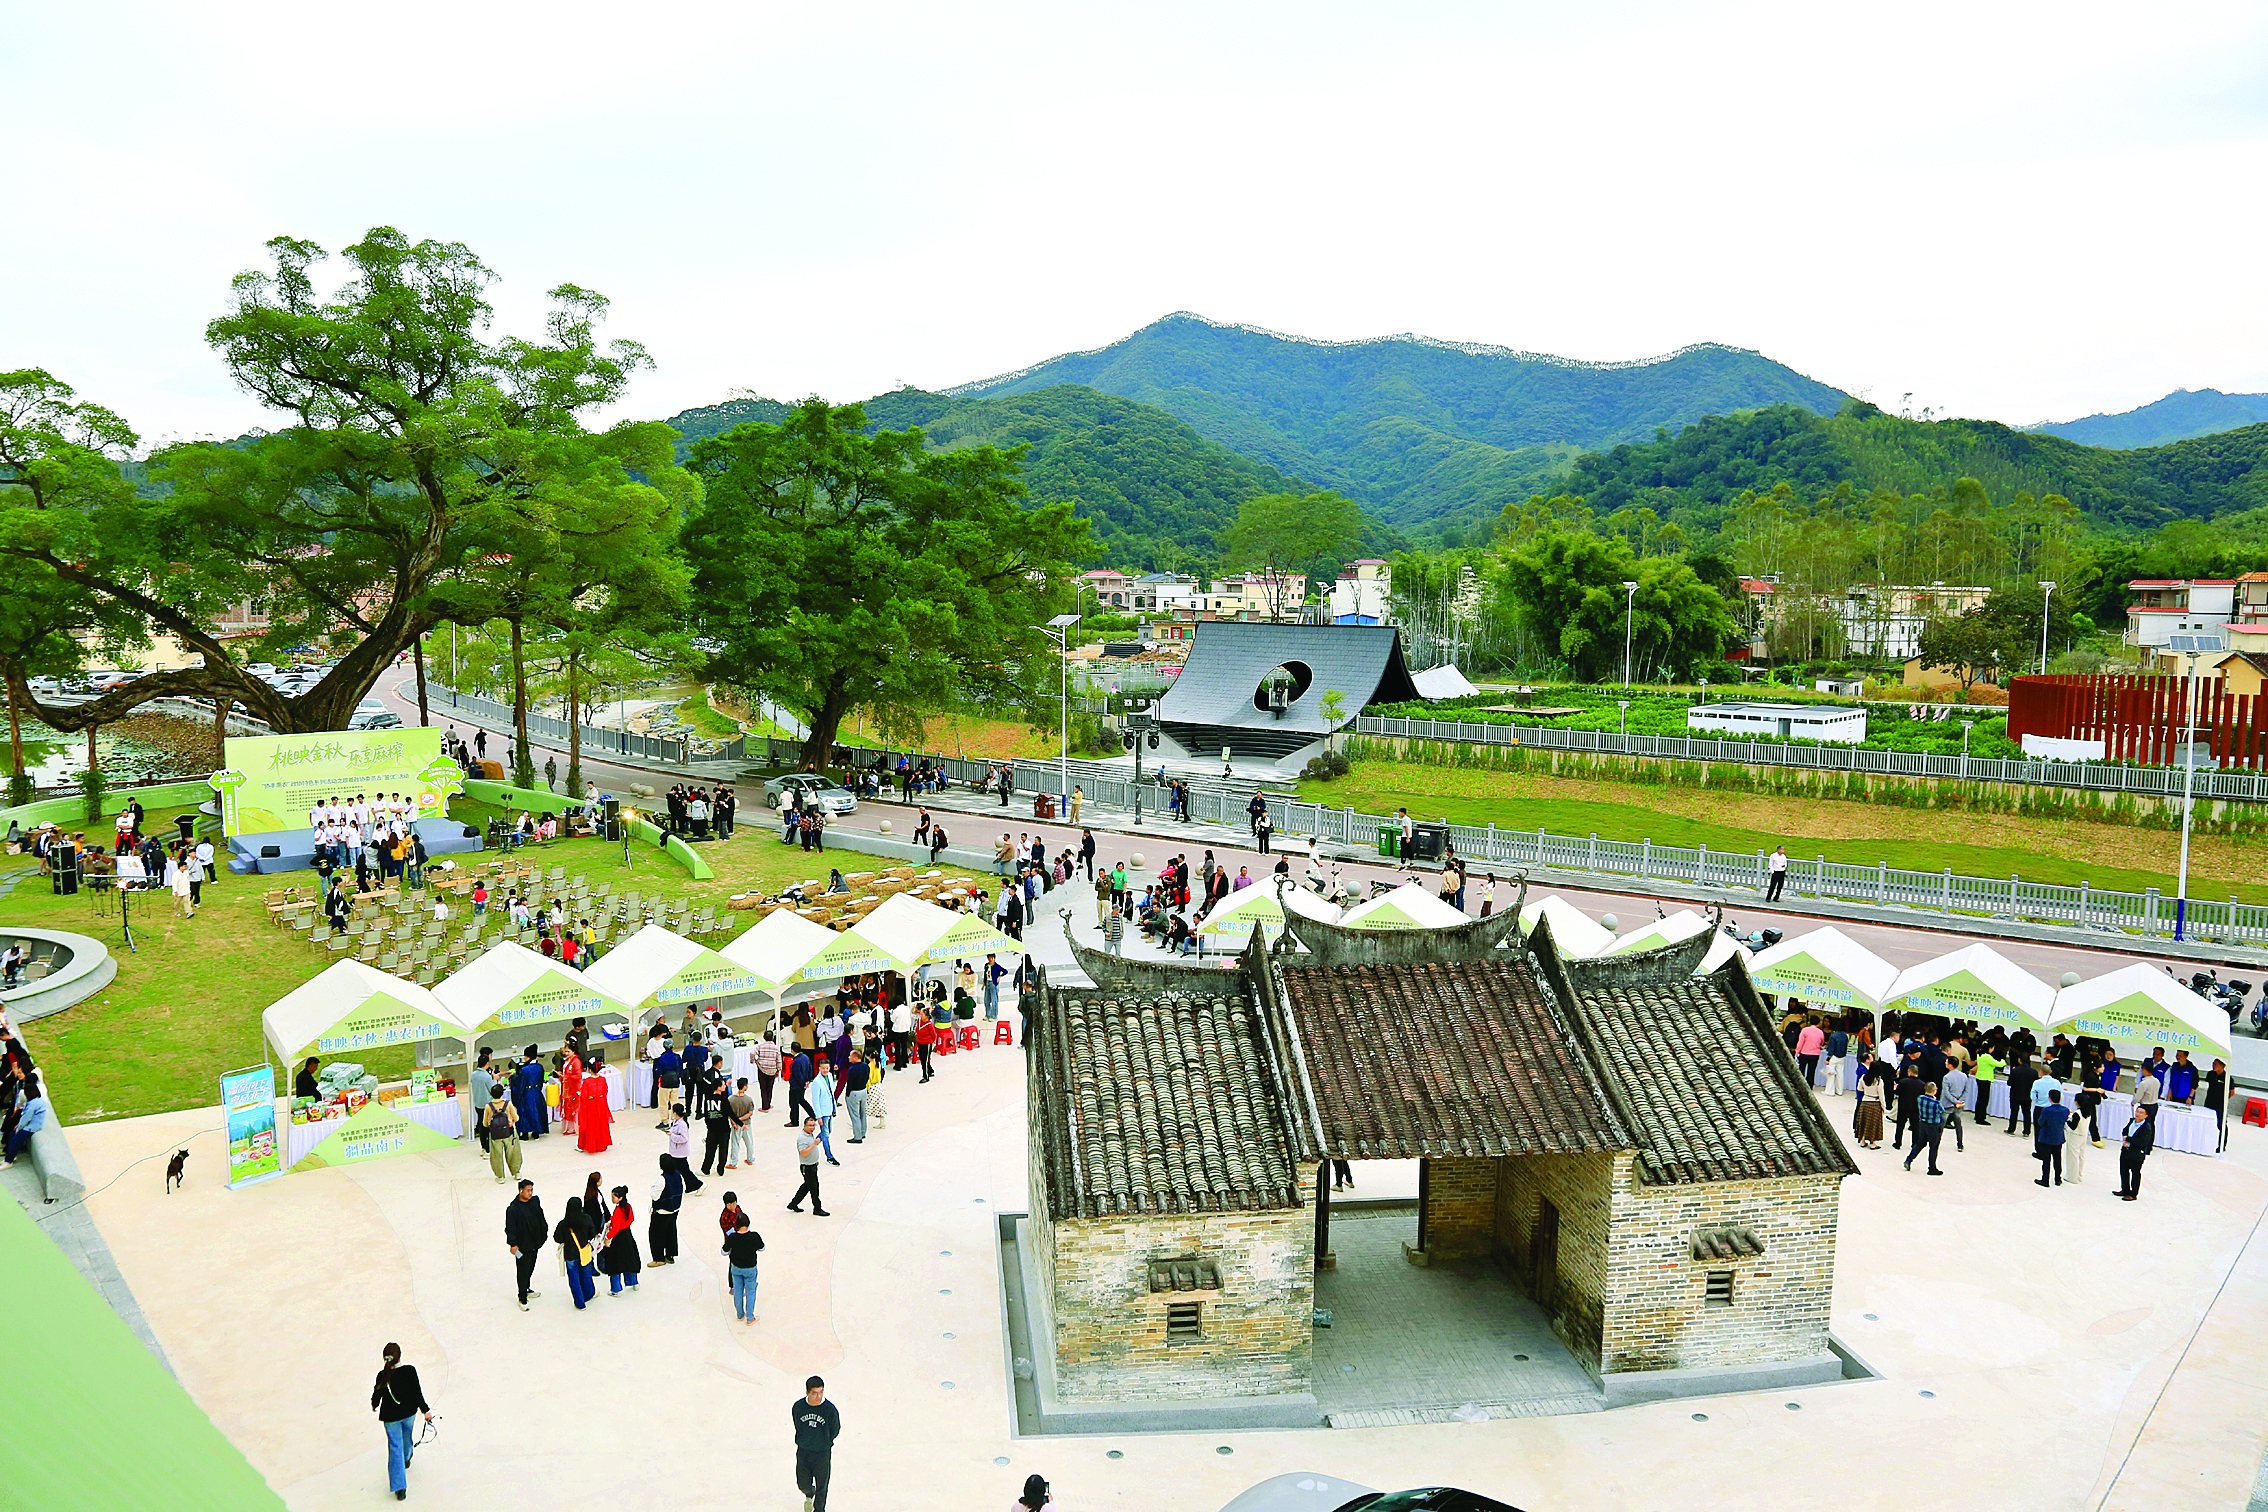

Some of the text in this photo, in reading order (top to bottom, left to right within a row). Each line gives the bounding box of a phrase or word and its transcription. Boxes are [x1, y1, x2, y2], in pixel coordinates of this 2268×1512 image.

[268, 741, 347, 778] 桃映金秋
[500, 998, 602, 1024] 桃映金秋·3D造物
[319, 1023, 441, 1052] 桃映金秋·惠农直播
[2076, 1019, 2200, 1047] 桃映金秋·文创好礼
